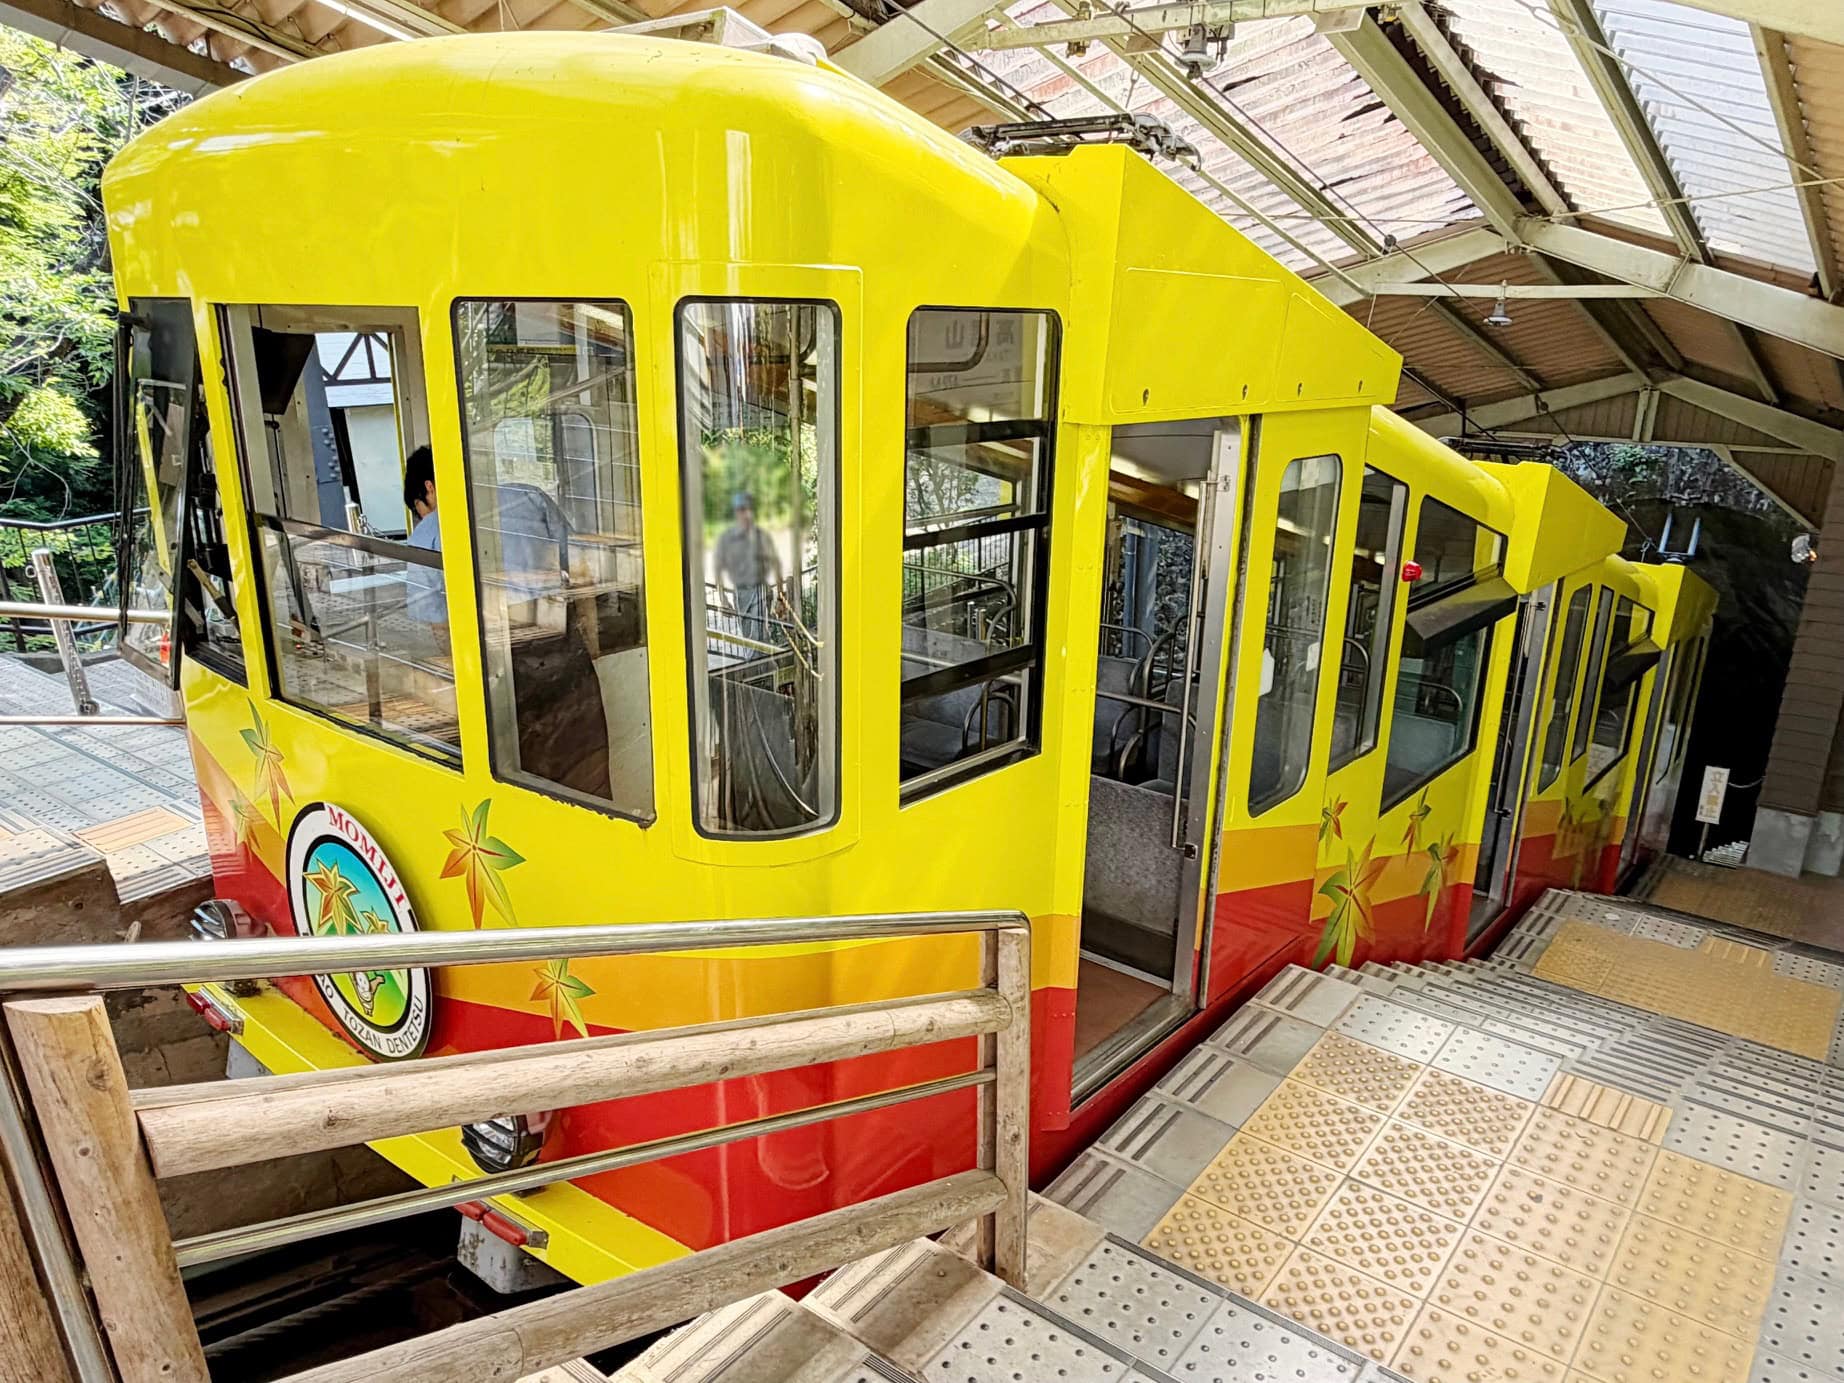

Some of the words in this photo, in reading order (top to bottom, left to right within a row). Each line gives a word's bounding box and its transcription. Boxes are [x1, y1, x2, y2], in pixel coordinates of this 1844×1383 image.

[327, 804, 405, 905] MOMIJI
[343, 1006, 383, 1050] TOZAN
[385, 995, 424, 1054] DENTETSU
